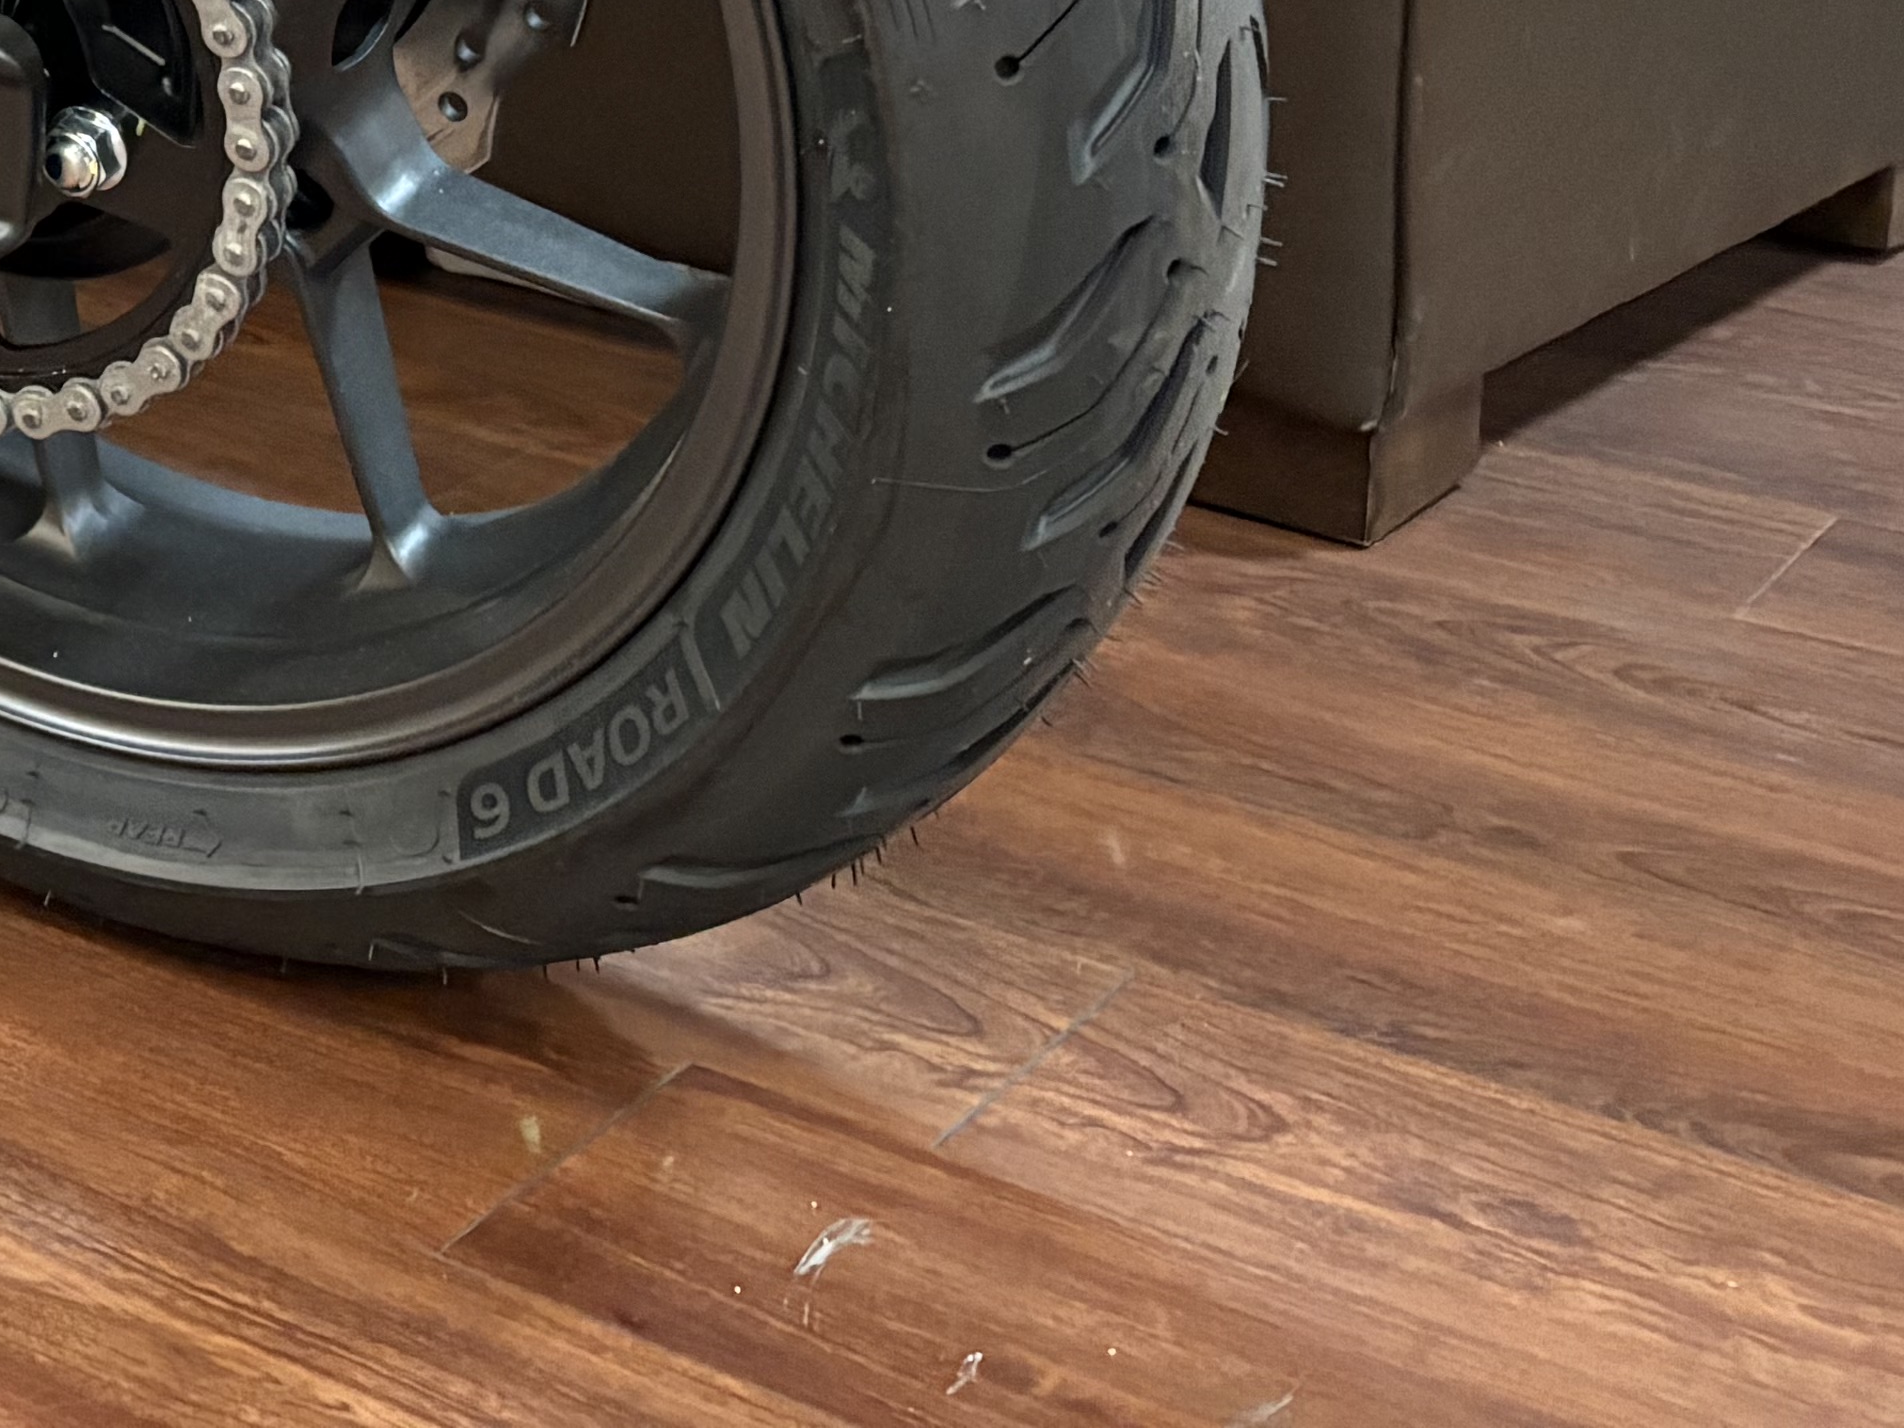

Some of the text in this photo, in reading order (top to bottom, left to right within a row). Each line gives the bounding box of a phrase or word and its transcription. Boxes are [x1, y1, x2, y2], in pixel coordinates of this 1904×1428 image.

[720, 229, 877, 659] MICHELIN
[469, 667, 689, 839] ROAD 6
